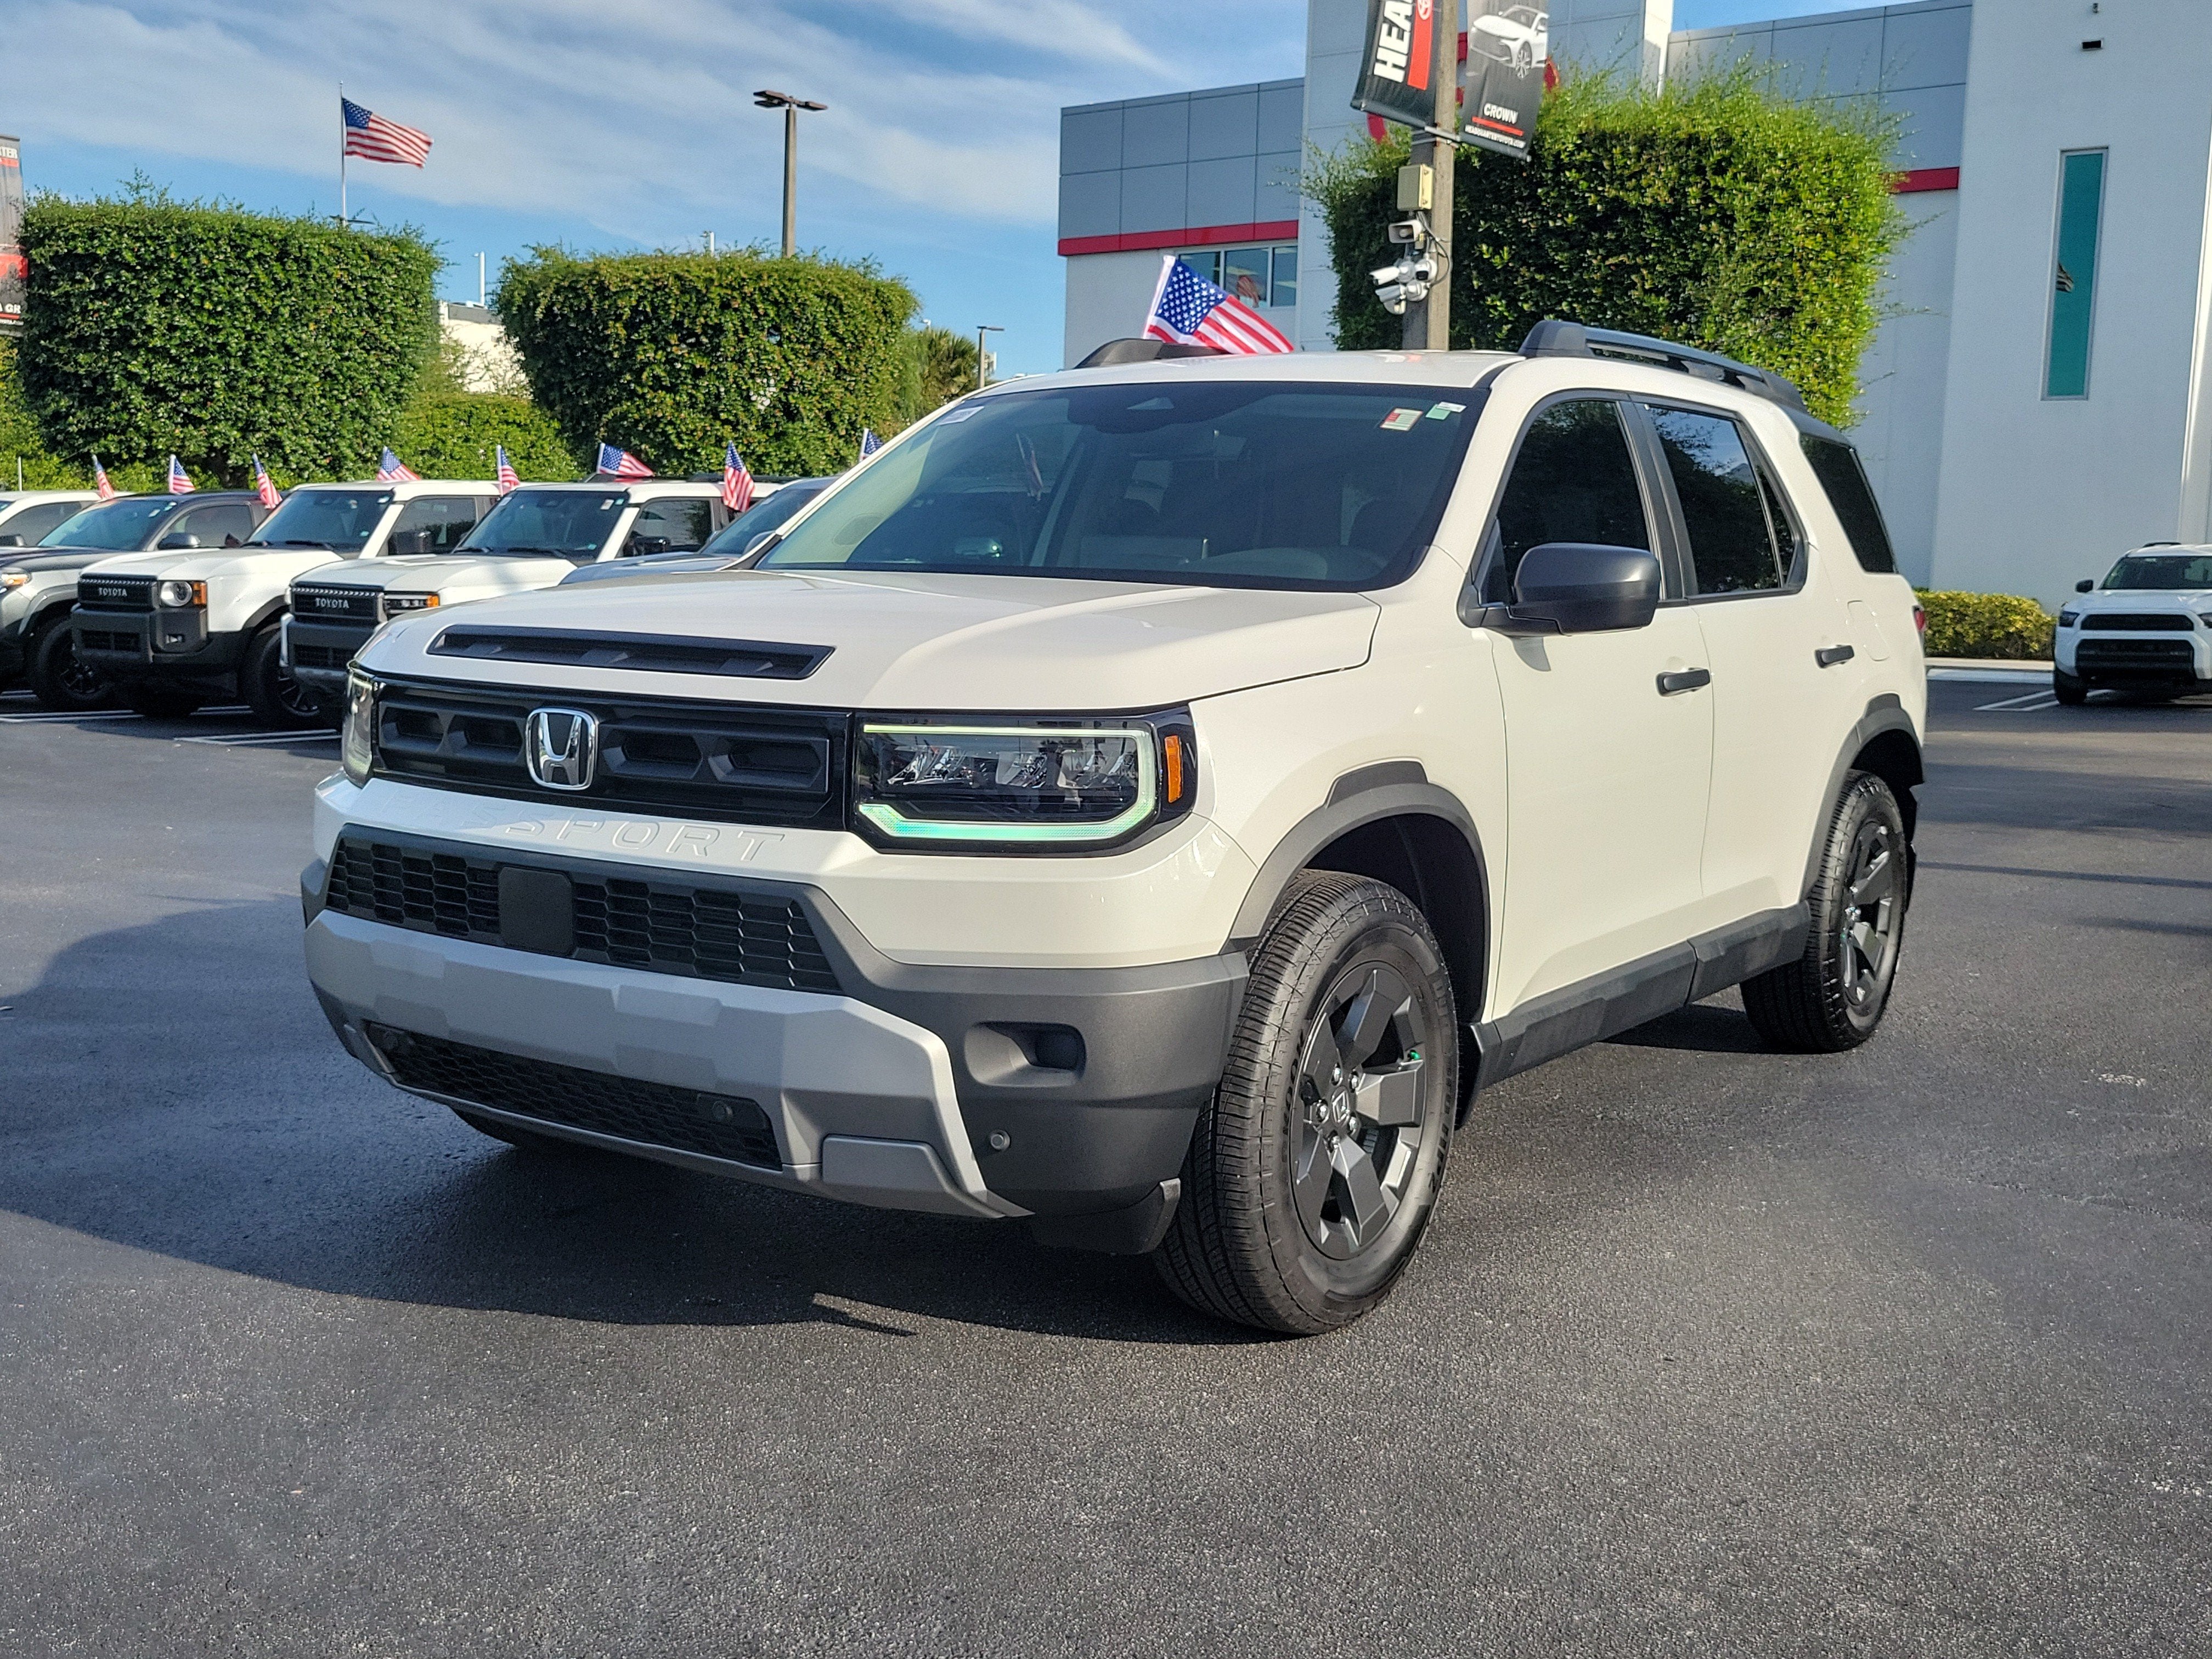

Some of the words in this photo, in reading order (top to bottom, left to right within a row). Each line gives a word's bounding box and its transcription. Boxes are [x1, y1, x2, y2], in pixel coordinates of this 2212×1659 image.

[1373, 0, 1413, 83] HEA
[1483, 103, 1519, 124] CROWN
[0, 146, 18, 159] TER
[98, 587, 127, 597] TOYOTA
[315, 597, 349, 608] TOYOTA
